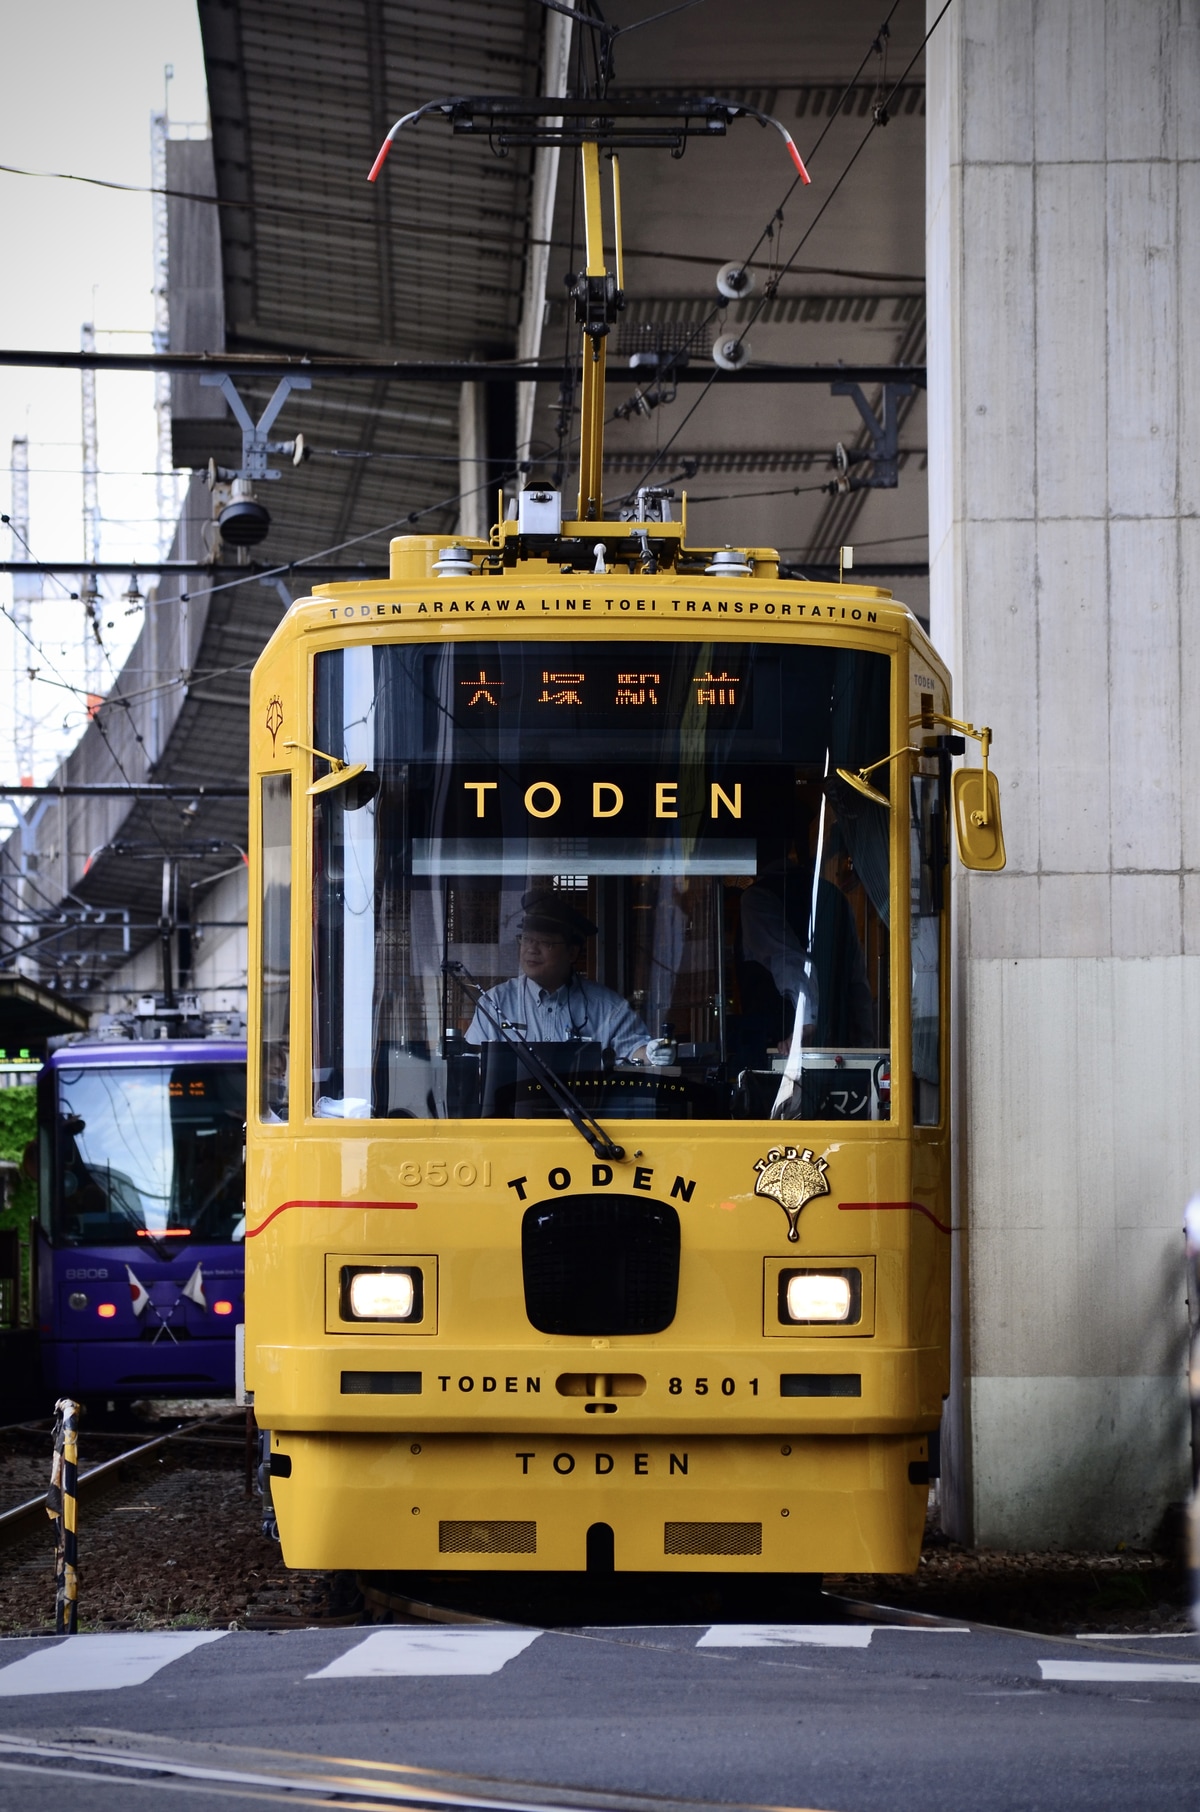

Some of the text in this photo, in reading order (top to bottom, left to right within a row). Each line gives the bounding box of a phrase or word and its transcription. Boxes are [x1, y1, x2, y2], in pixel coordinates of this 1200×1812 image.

[329, 599, 878, 623] TODEN ARAKAWA LINE TOEI TRANSPORTATION
[460, 670, 740, 706] 大塚駅前
[913, 673, 935, 690] TODEN
[463, 781, 742, 819] TODEN
[527, 1080, 686, 1093] TOI TRANSPORTATION
[752, 1146, 831, 1173] TODEN
[398, 1160, 491, 1188] 8501
[507, 1163, 697, 1203] TODEN
[437, 1375, 759, 1396] TODEN 8501
[515, 1452, 689, 1475] TODEN
